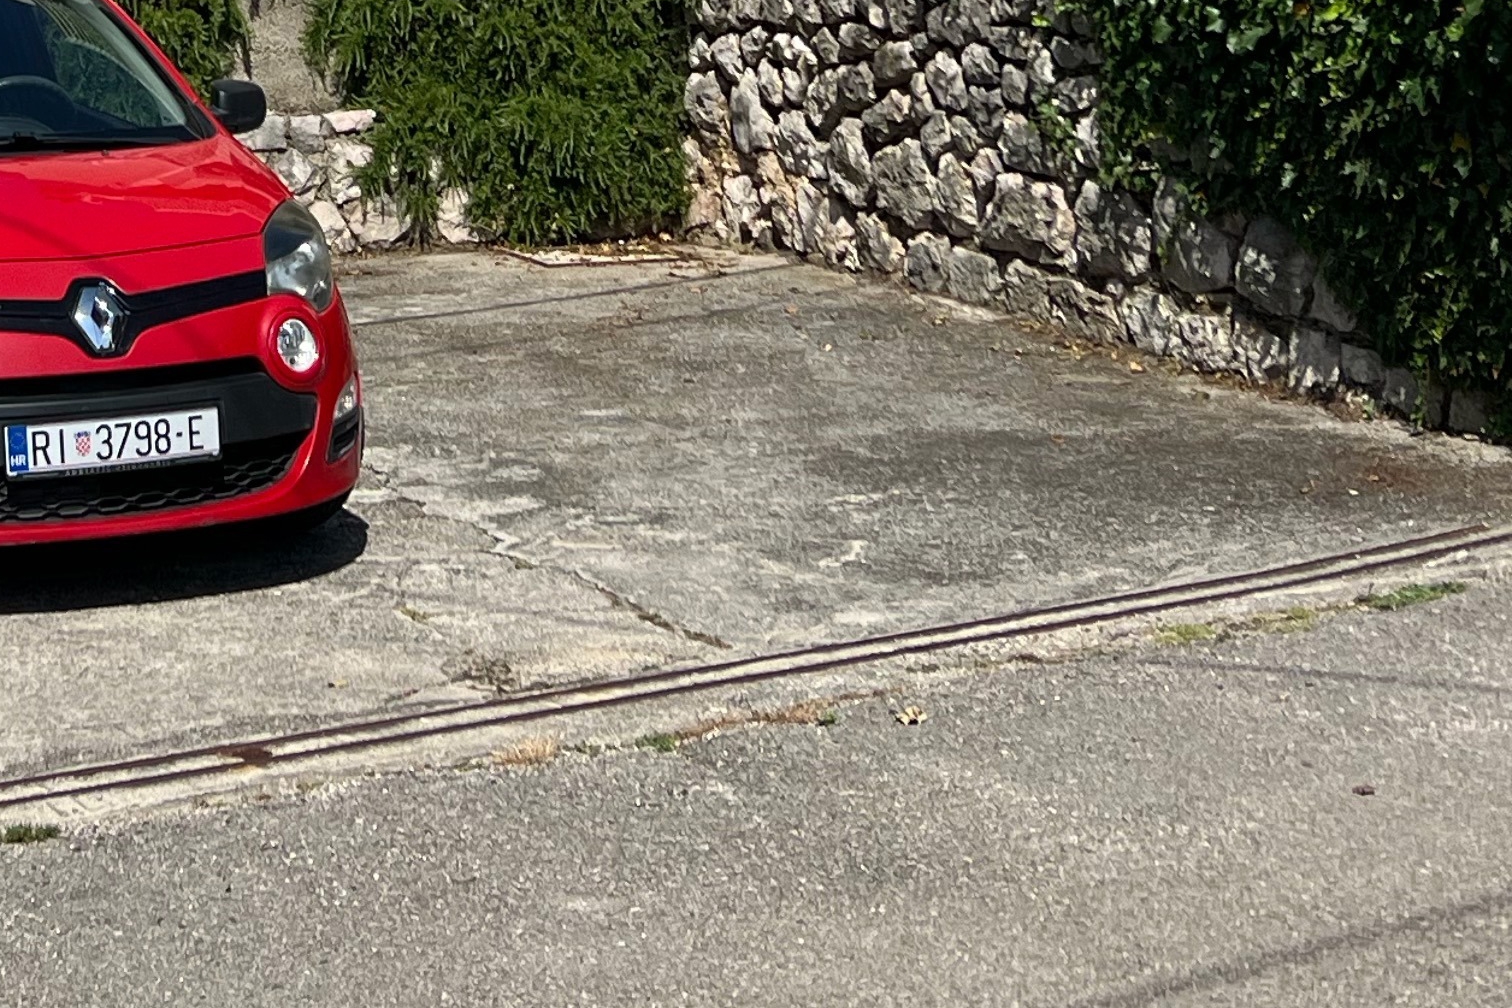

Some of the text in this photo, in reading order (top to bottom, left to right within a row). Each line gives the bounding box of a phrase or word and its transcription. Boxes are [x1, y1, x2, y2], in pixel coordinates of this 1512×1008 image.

[31, 415, 205, 466] RI 3798-E
[10, 454, 27, 466] HR
